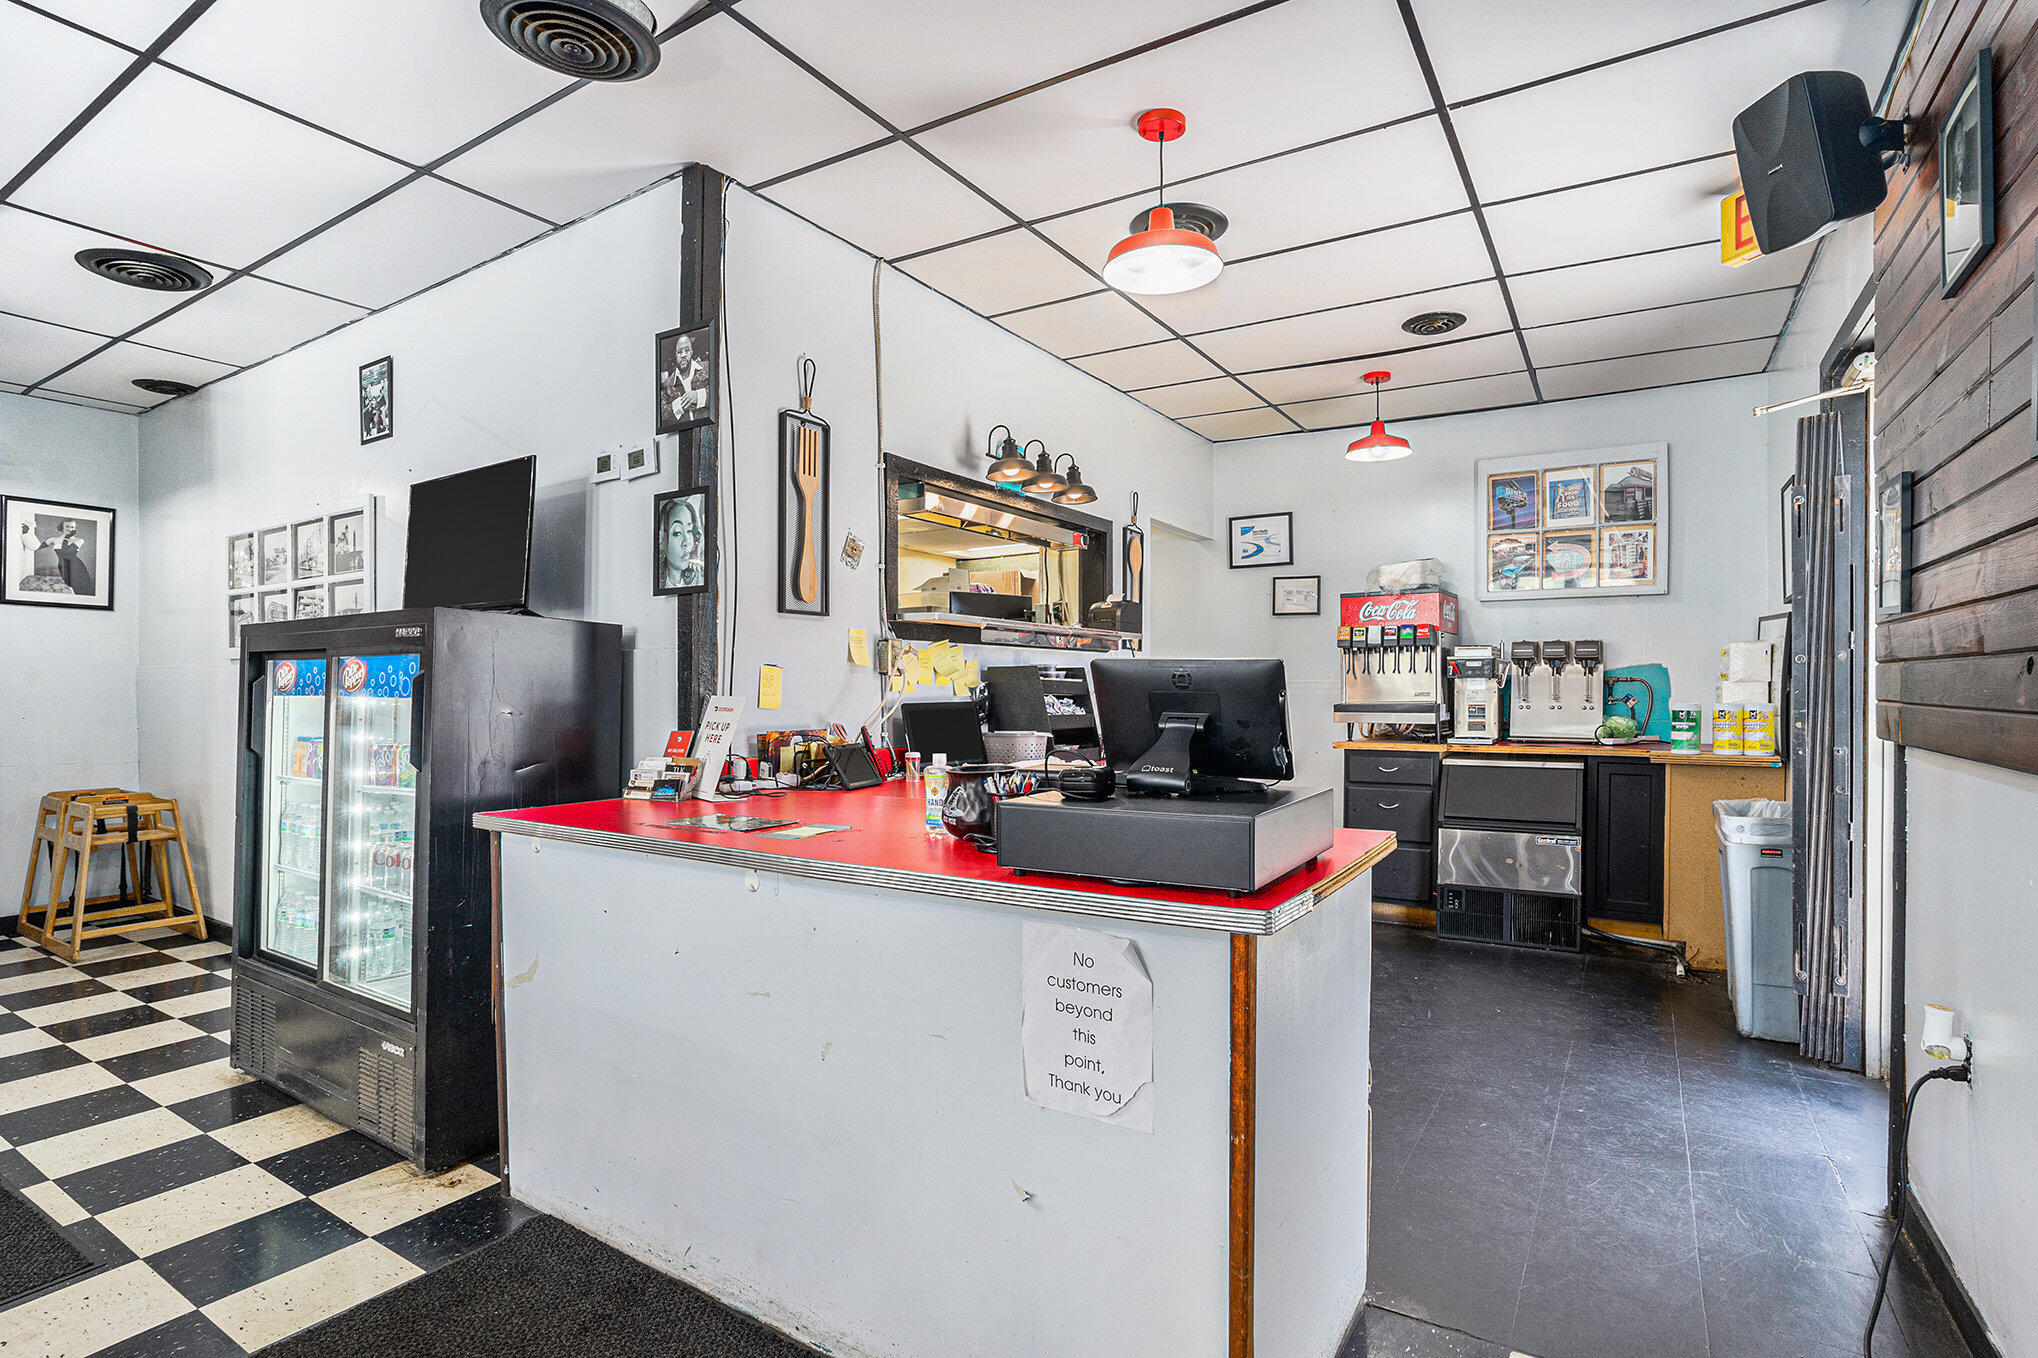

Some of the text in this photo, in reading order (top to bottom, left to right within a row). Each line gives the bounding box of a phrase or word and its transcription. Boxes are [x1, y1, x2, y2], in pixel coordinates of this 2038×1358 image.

[1555, 552, 1577, 562] EAT
[1359, 600, 1419, 622] Coca-Cola
[705, 721, 731, 732] PICK UP
[705, 733, 722, 744] HERE
[1151, 765, 1175, 773] toast
[1073, 951, 1095, 968] No
[1046, 975, 1123, 998] customers
[1055, 998, 1113, 1022] beyond
[1072, 1028, 1096, 1044] this
[1064, 1054, 1105, 1075] point,
[1048, 1073, 1122, 1104] Thank you
